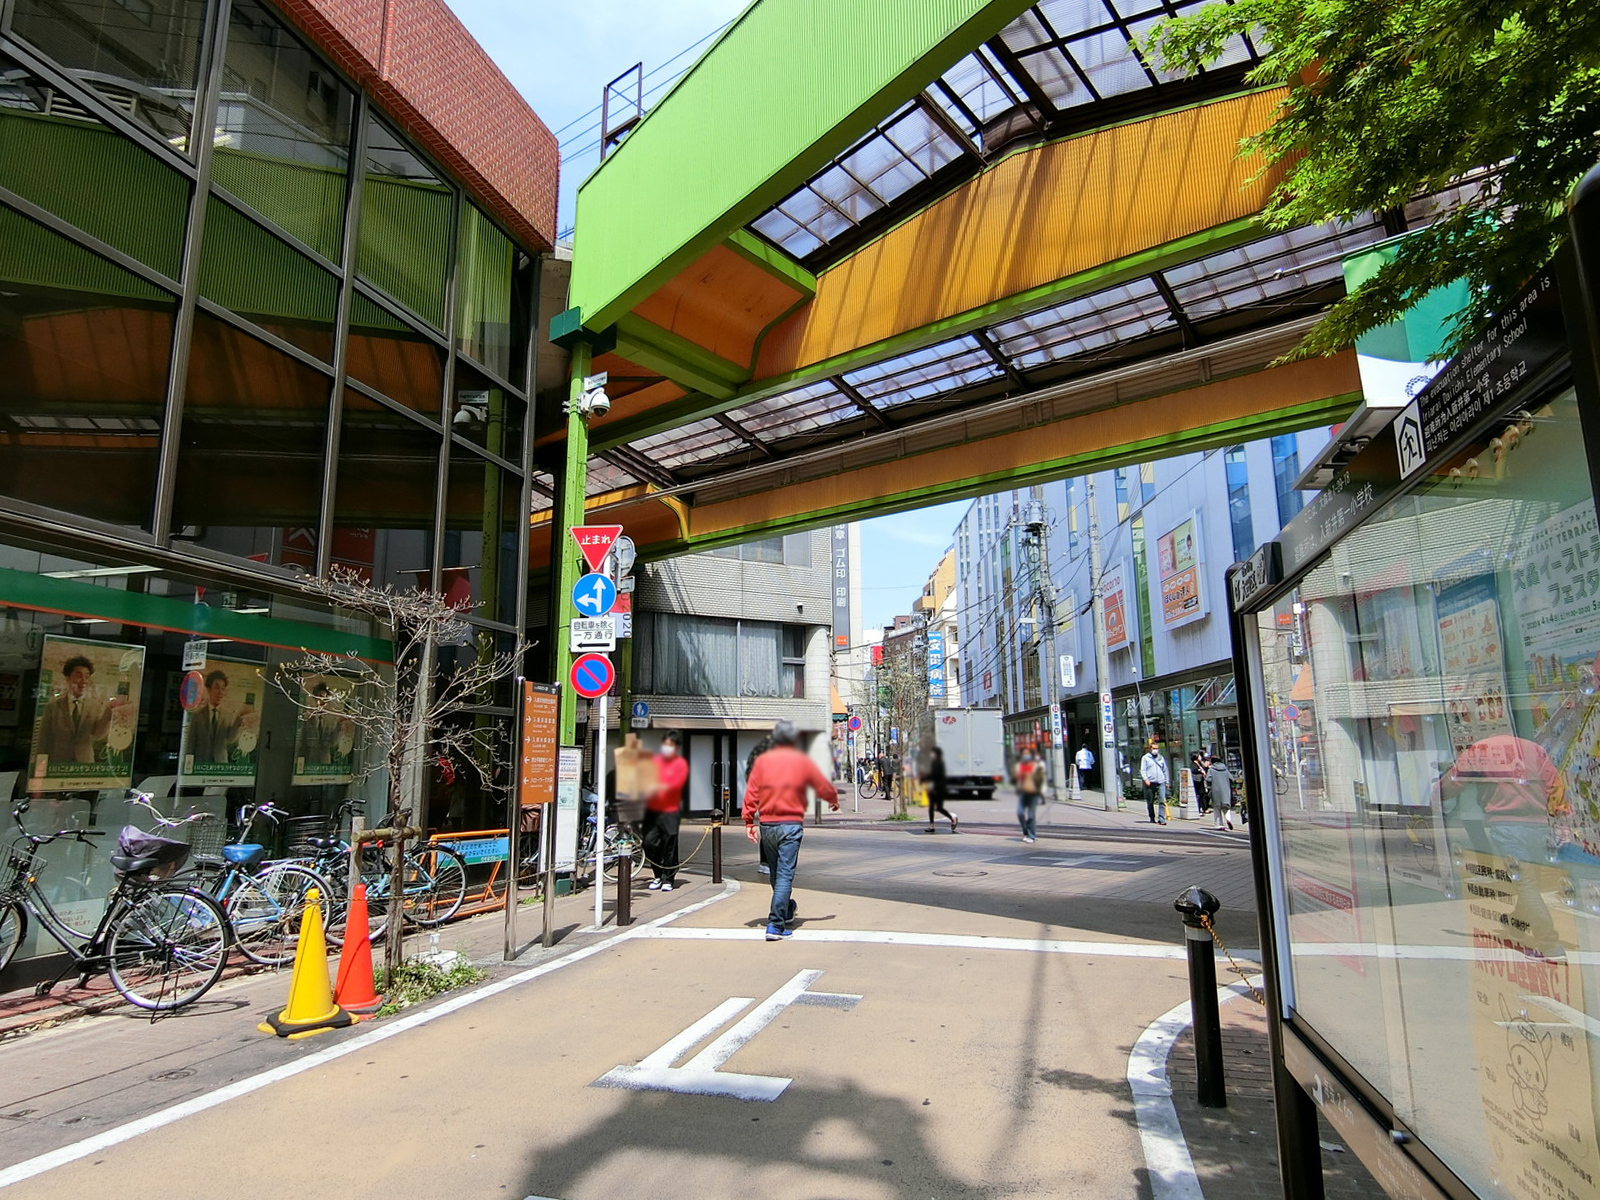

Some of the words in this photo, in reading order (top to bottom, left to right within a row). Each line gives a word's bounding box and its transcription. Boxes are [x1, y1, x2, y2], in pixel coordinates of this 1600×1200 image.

[1430, 365, 1460, 398] evacuation
[1461, 340, 1484, 369] shelter
[1487, 327, 1498, 343] for
[1500, 309, 1518, 330] this
[1520, 289, 1538, 312] area
[1540, 277, 1550, 291] is
[1422, 398, 1442, 422] Iriarai
[1442, 376, 1465, 404] Daiichi
[1466, 344, 1502, 382] Elementary
[1503, 318, 1528, 348] School
[1496, 360, 1528, 396] 초등학교
[580, 534, 612, 545] 止まれ
[1556, 518, 1598, 544] TERRACE
[574, 620, 612, 630] 自転車を除く
[574, 630, 612, 640] 一方通行
